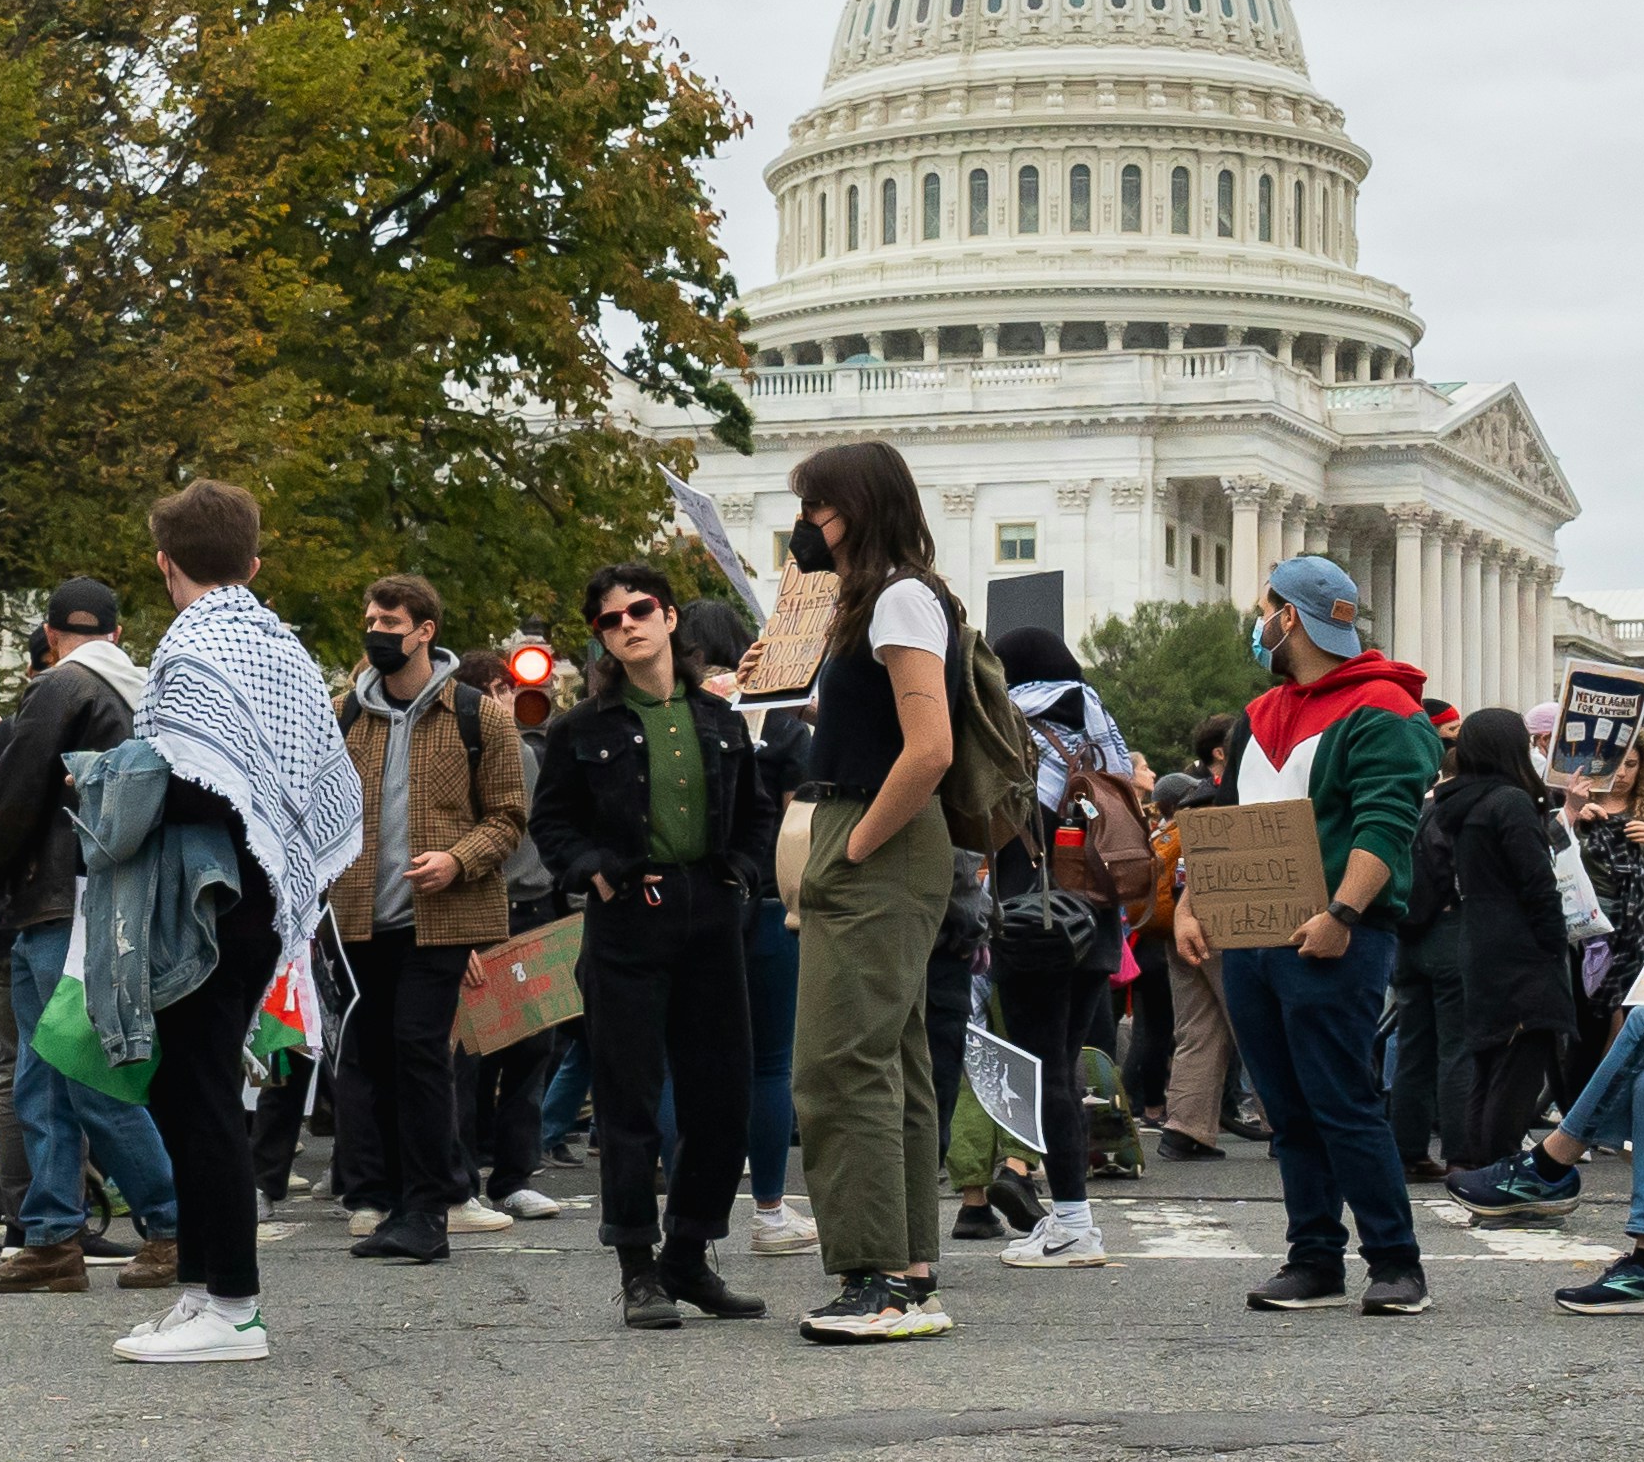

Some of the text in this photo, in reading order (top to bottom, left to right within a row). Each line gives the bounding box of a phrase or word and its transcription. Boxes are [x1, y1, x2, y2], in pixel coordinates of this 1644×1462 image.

[1576, 691, 1606, 706] NEVER
[1577, 704, 1594, 714] FOR
[1187, 810, 1291, 845] STOP THE
[1191, 858, 1299, 891] GENOCIDE
[1231, 903, 1279, 932] GAZA
